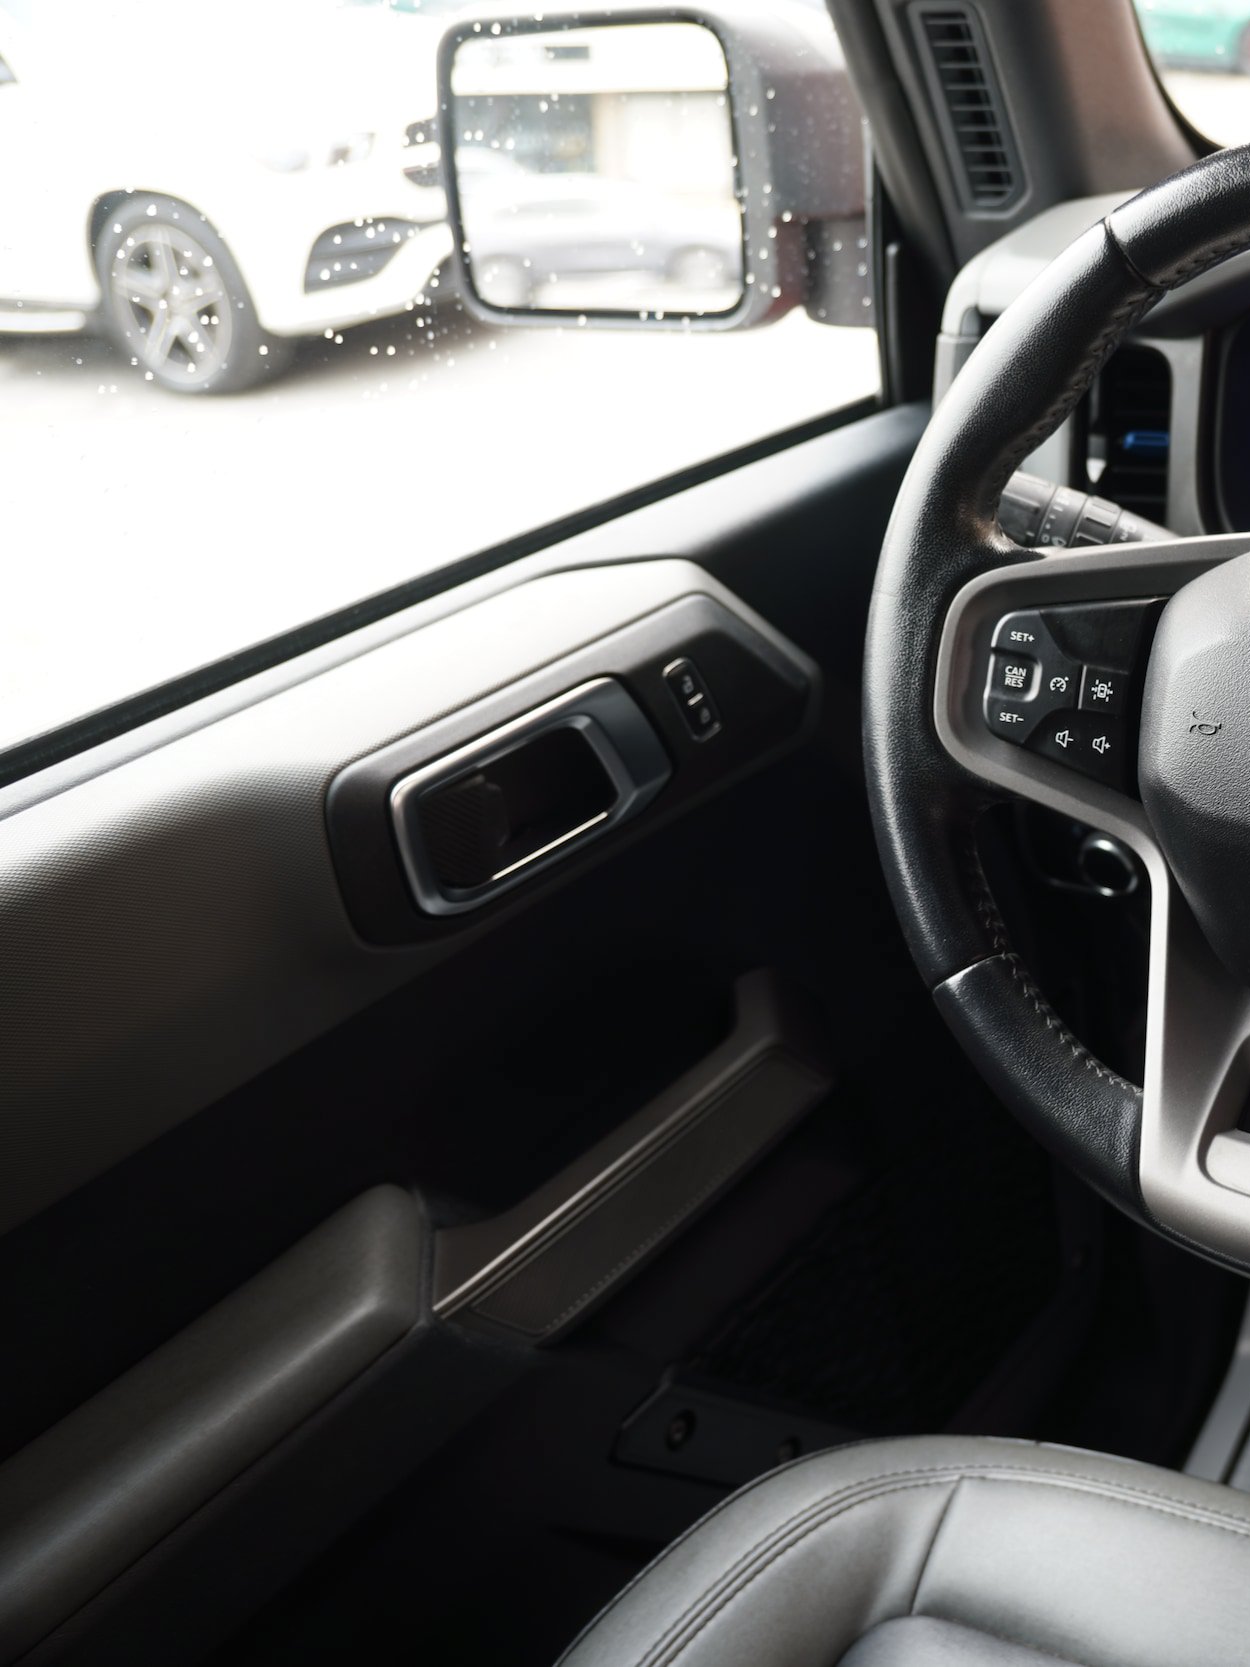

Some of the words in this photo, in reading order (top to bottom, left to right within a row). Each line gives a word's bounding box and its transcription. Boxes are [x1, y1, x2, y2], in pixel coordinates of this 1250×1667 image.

[1010, 631, 1035, 643] SET+
[1005, 665, 1027, 677] CAN
[1004, 677, 1024, 689] RES
